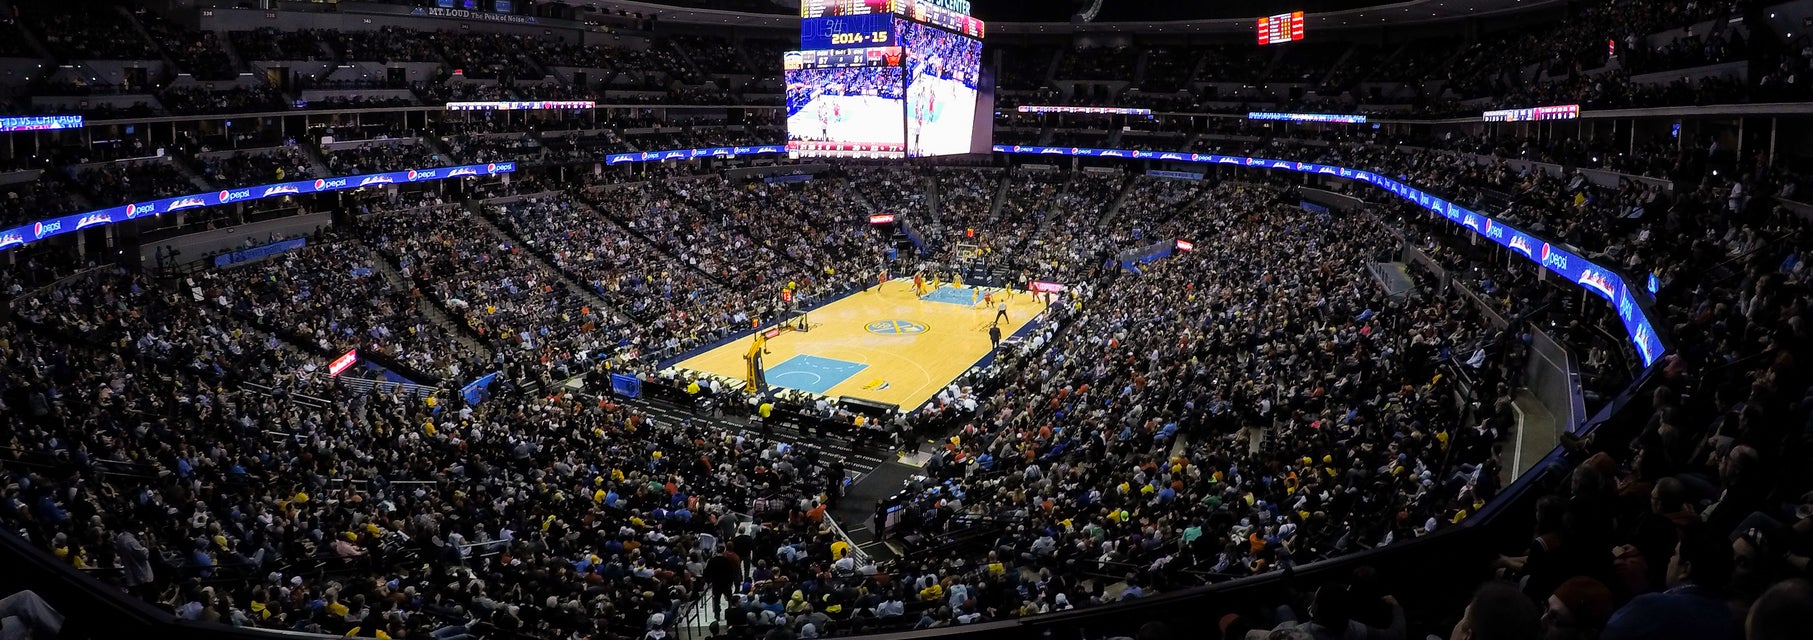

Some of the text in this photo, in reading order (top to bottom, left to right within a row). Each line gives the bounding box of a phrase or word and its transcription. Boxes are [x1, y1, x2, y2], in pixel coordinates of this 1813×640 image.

[428, 7, 445, 16] MT.
[446, 9, 470, 18] LOUD
[471, 12, 484, 20] The
[824, 19, 843, 37] 34
[831, 32, 863, 45] 2014
[871, 31, 888, 43] 15
[496, 163, 512, 172] pepsi
[417, 170, 436, 180] pepsi
[326, 178, 347, 189] pepsi
[229, 189, 250, 201] pepsi
[136, 202, 155, 215] pepsi
[43, 220, 61, 235] pepsi
[1549, 252, 1568, 270] pepsi
